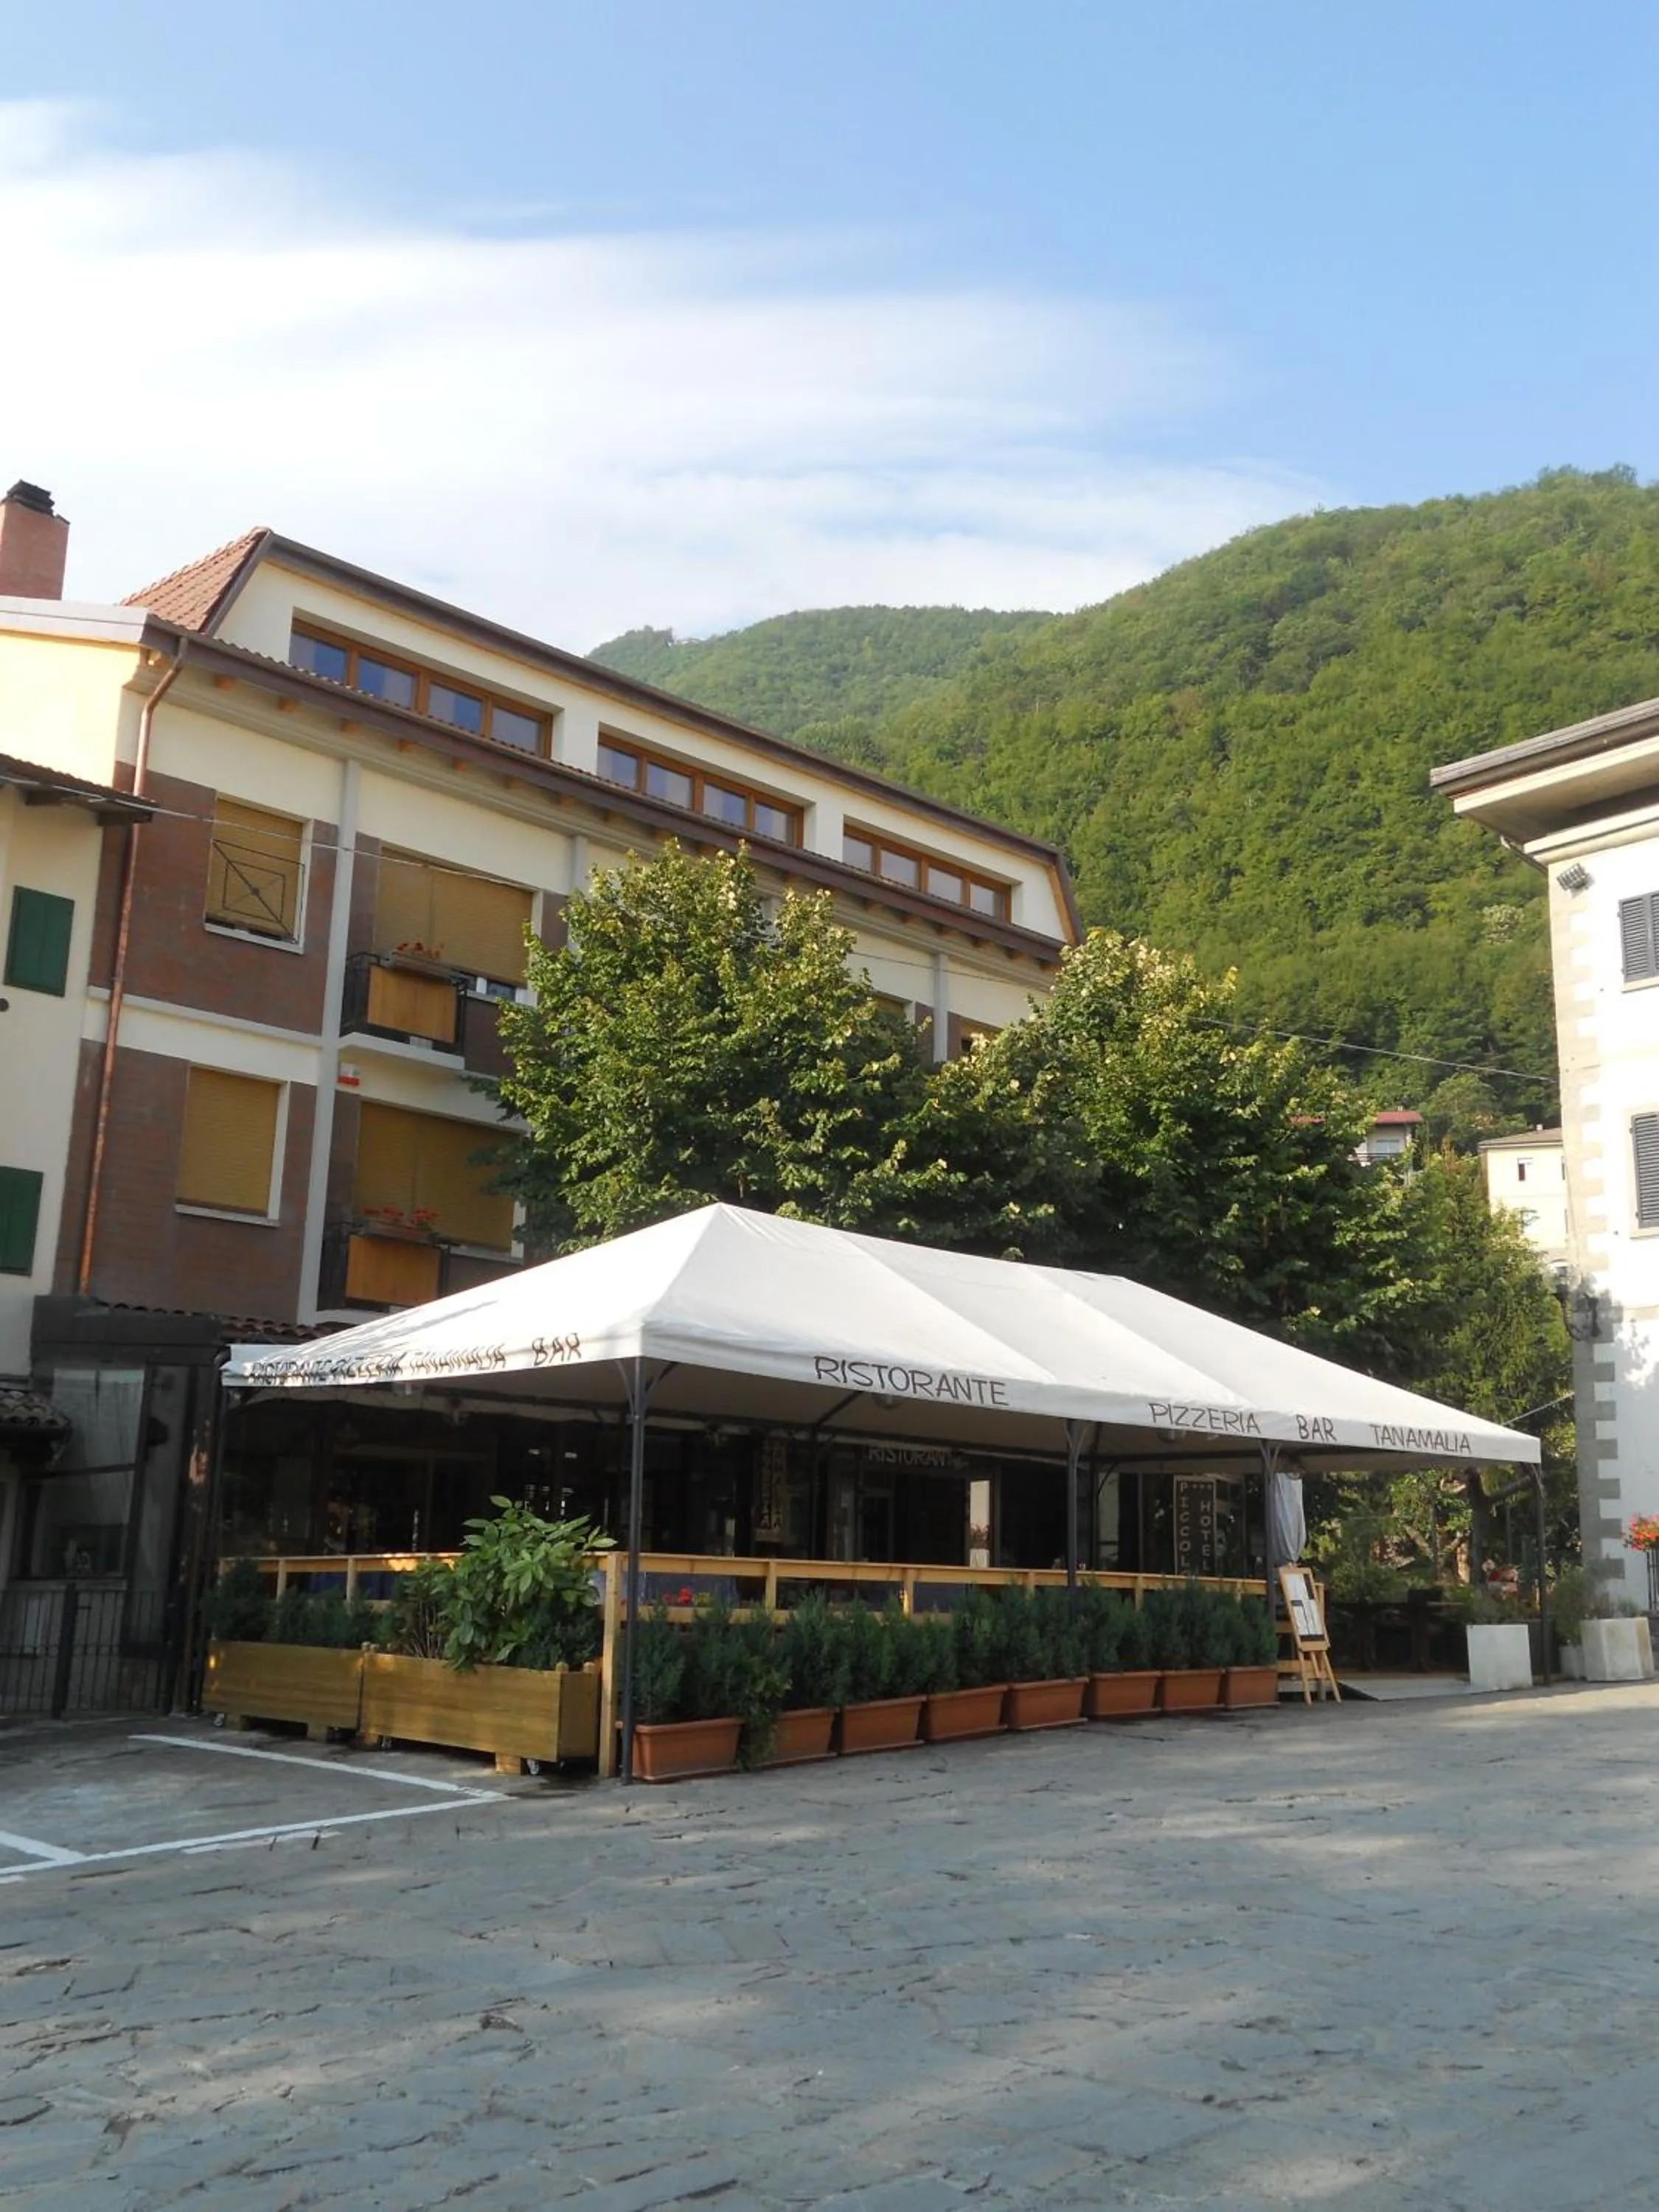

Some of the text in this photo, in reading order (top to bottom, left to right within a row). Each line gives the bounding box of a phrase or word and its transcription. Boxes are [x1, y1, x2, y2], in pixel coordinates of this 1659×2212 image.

[409, 1343, 507, 1376] TANAMALIA
[532, 1332, 582, 1366] BAR
[814, 1356, 1472, 1454] RISTORANTE PIZZERIA BAR TANAMALIA
[1200, 1500, 1211, 1571] HOTEL
